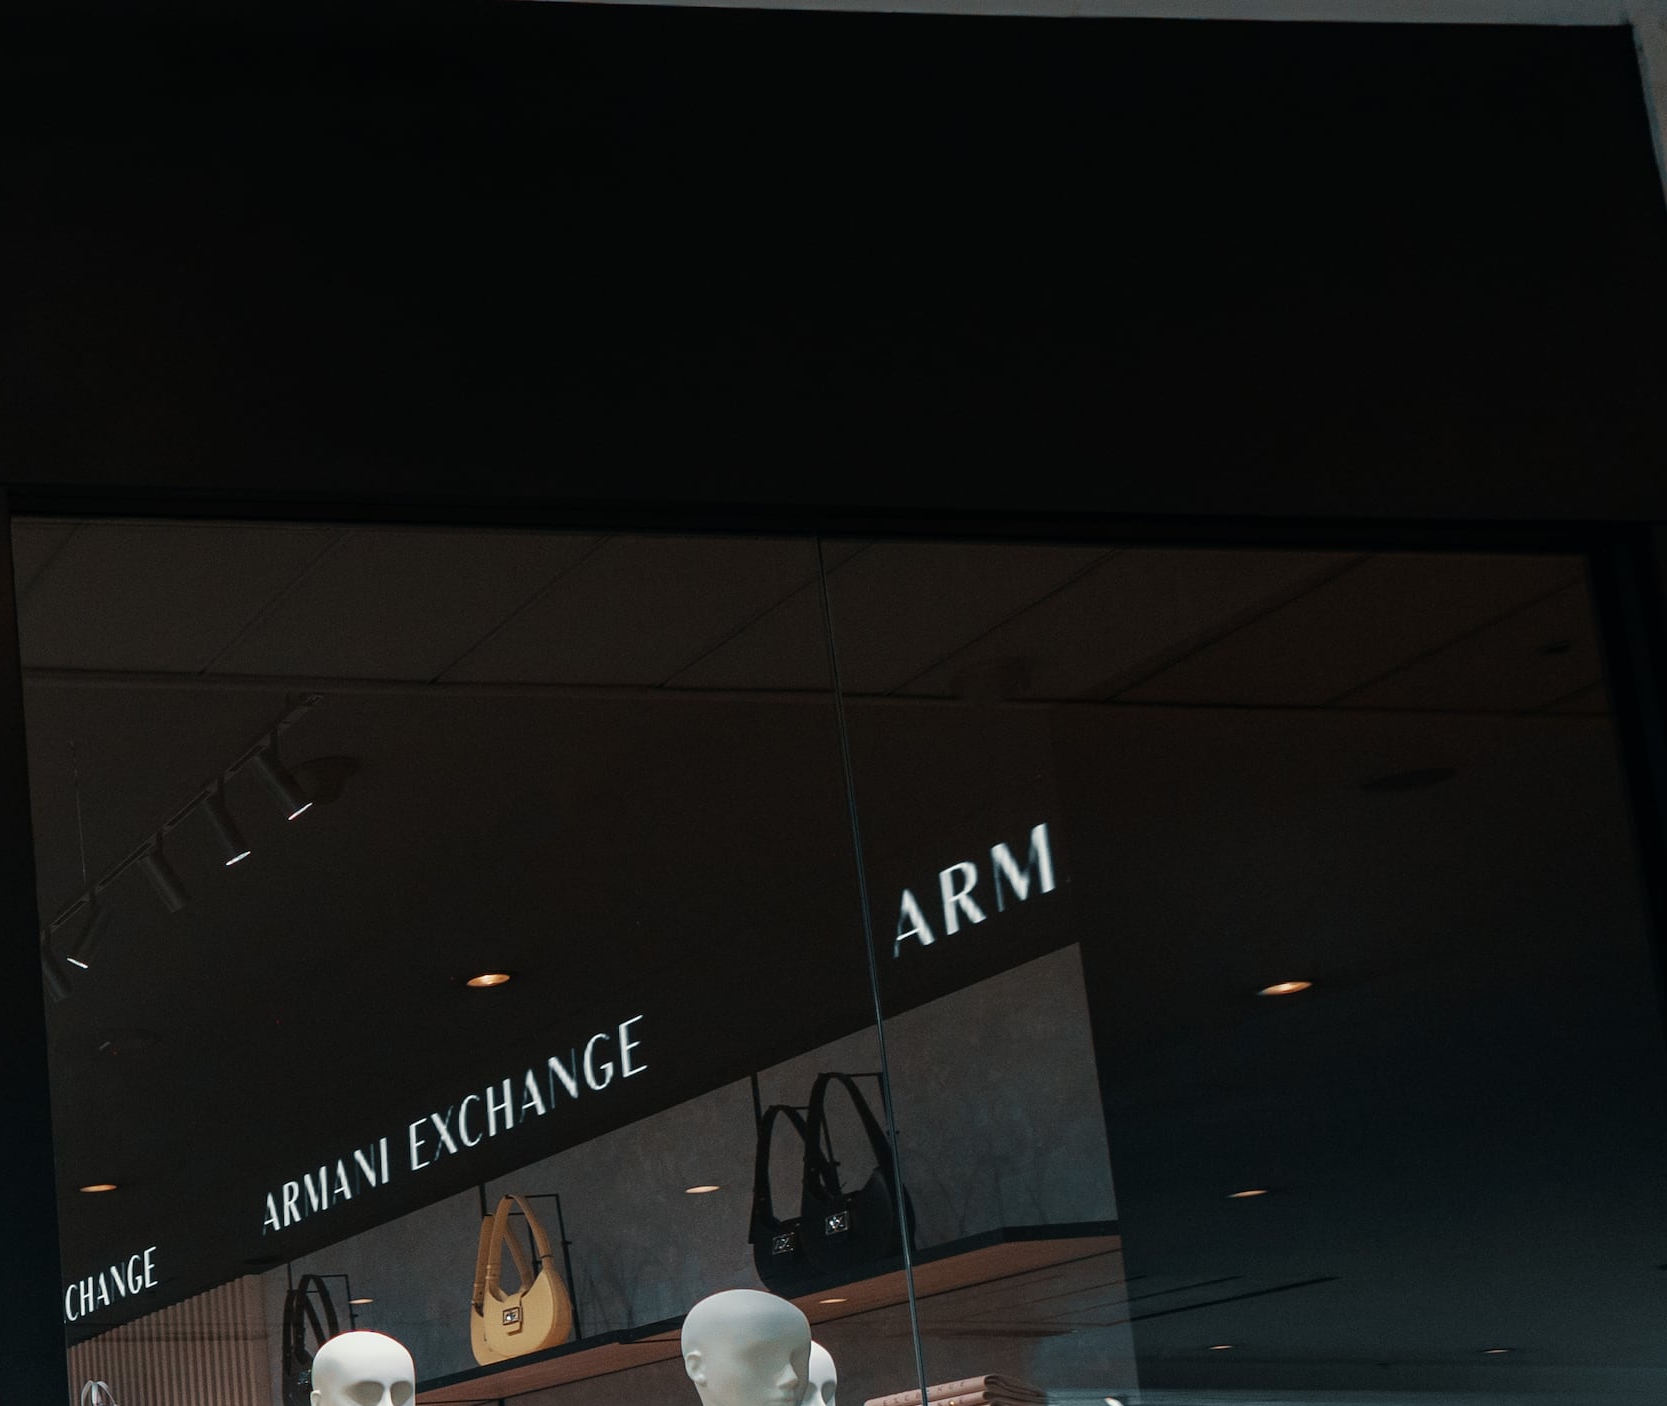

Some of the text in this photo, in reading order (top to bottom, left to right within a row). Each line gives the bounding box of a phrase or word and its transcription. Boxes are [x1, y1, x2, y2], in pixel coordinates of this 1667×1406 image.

[264, 1015, 647, 1234] ARMANI EXCHANGE
[64, 1246, 159, 1324] CHANGE
